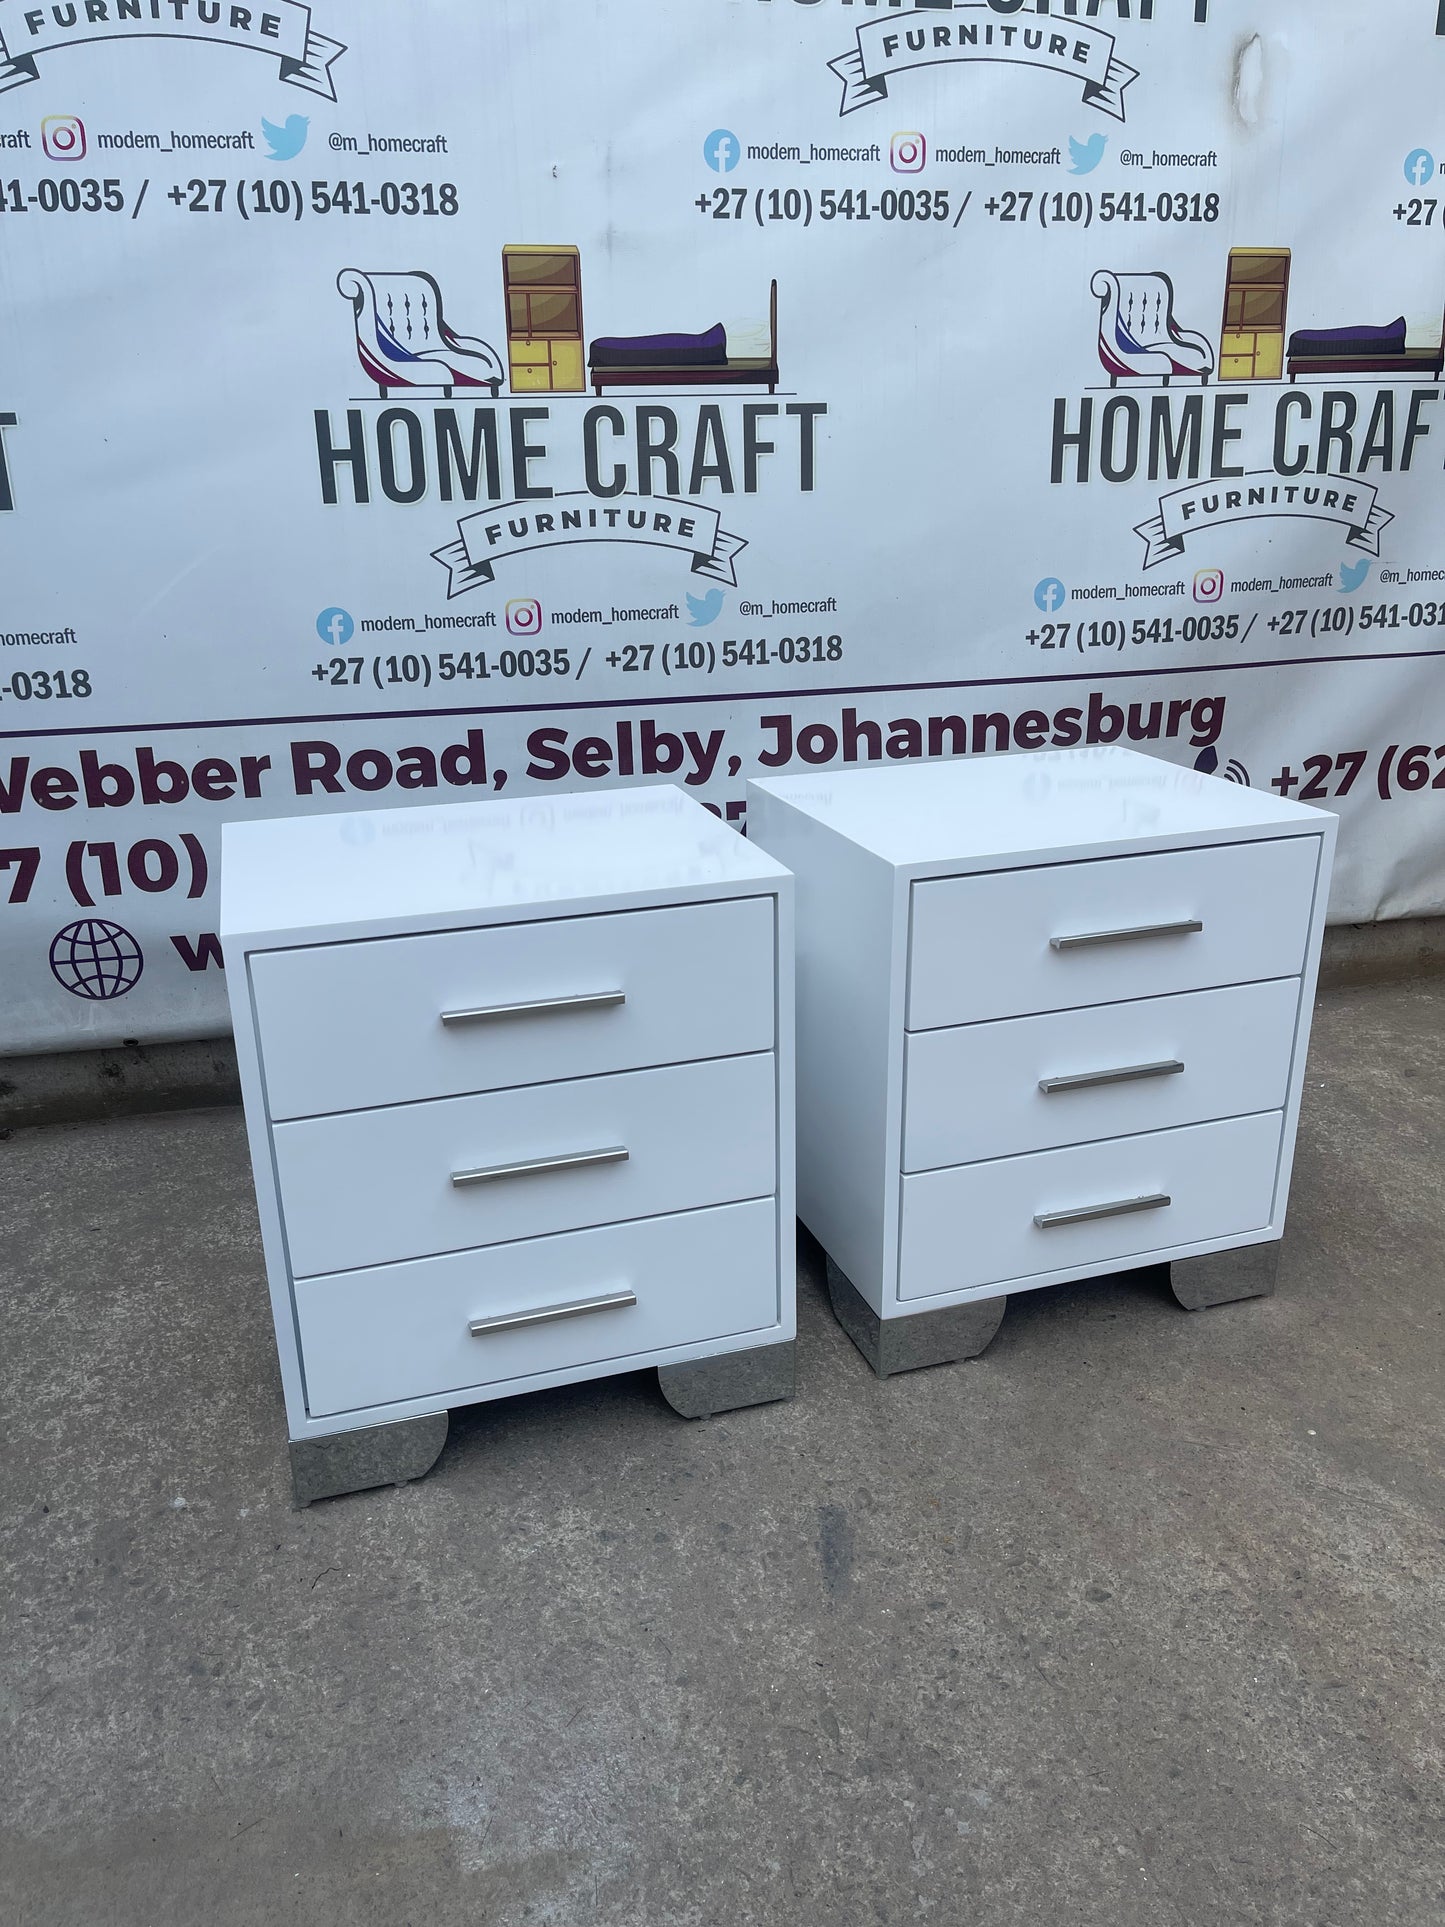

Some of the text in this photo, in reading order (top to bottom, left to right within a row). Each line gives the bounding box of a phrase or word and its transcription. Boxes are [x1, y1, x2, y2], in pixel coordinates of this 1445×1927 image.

[882, 24, 1093, 63] FURNITURE
[97, 130, 255, 153] modern_homecraft
[328, 132, 449, 156] @m_homecraft
[747, 142, 881, 164] modern_homecraft
[935, 145, 1062, 167] modern_homecraft
[1120, 149, 1218, 170] @m_homecraft
[167, 178, 227, 213] +27
[236, 179, 304, 221] (10)
[311, 180, 459, 216] 541-0318
[694, 187, 748, 220] +27
[754, 188, 813, 227] (10)
[819, 189, 950, 222] 541-0035
[984, 190, 1034, 222] +27
[1039, 191, 1093, 229] (10)
[1099, 191, 1220, 223] 541-0318
[1392, 198, 1438, 226] +27
[1049, 389, 1445, 484] HOME CRAF
[313, 402, 829, 505] HOME CRAFT
[1180, 485, 1360, 522] FURNITURE
[484, 507, 696, 545] FURNITURE
[1071, 580, 1186, 601] modern_homecraft
[1230, 572, 1334, 593] modern_homecraft
[360, 611, 497, 633] modern_homecraft
[551, 603, 680, 625] modern_homecraft
[739, 596, 837, 618] @m_homecraft
[1025, 623, 1071, 650] +27
[1076, 620, 1126, 654] (10)
[1131, 614, 1242, 645] 541-0035
[1267, 609, 1308, 635] +27
[1310, 606, 1354, 638] (10)
[311, 656, 365, 686] +27
[372, 654, 432, 690] (10)
[438, 648, 571, 681] 541-0035
[605, 644, 655, 672] +27
[661, 641, 716, 676] (10)
[721, 634, 843, 667] 541-0318
[290, 728, 508, 796] Road,
[525, 719, 742, 786] Selby,
[756, 692, 1228, 769] Johannesburg
[1271, 750, 1368, 801] +27
